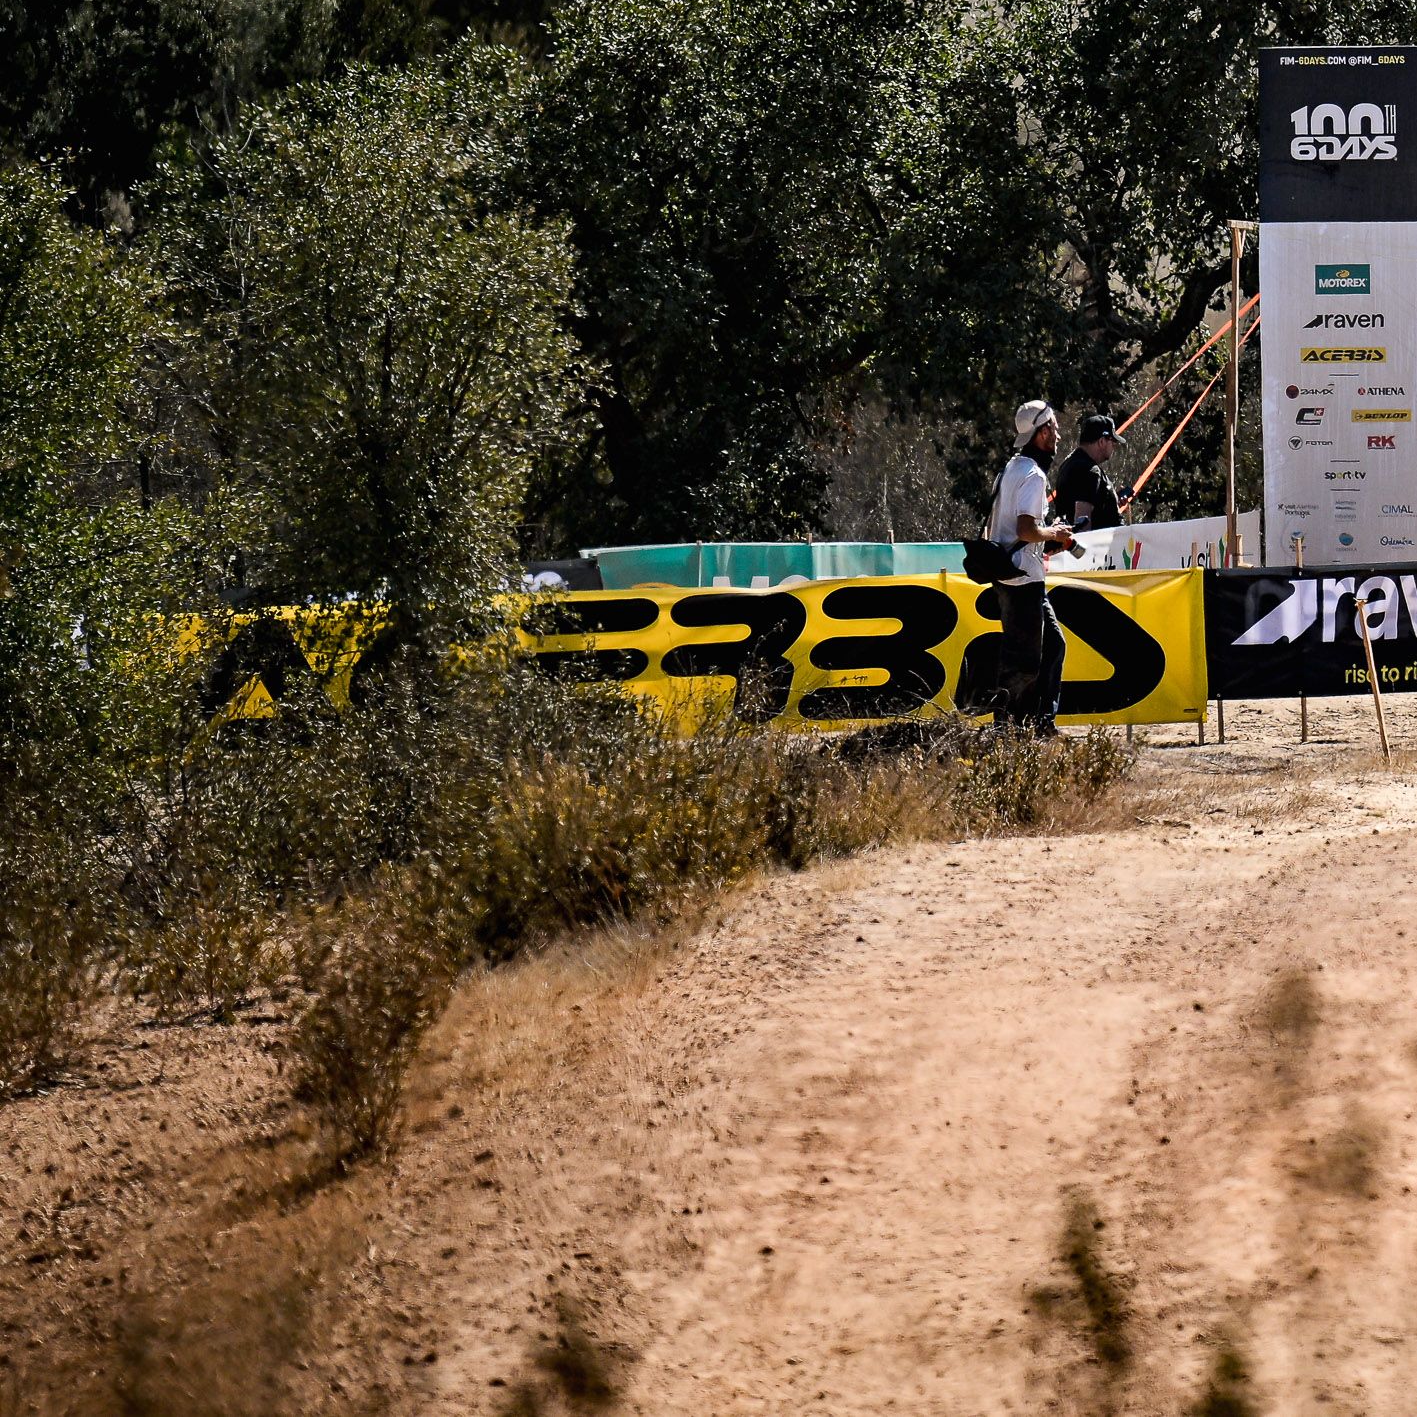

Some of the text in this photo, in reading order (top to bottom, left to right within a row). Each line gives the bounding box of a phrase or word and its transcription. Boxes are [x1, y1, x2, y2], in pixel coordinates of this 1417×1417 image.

[1280, 55, 1405, 66] FIM-6DAYS.COM @FIM_6DAYS
[1319, 278, 1366, 288] MOTOREX
[1324, 313, 1385, 329] raven
[1367, 387, 1406, 396] ATHENA
[1363, 412, 1408, 420] DUNLOP
[1367, 435, 1396, 447] RK
[1381, 504, 1413, 514] CIMAL
[1380, 664, 1400, 683] to
